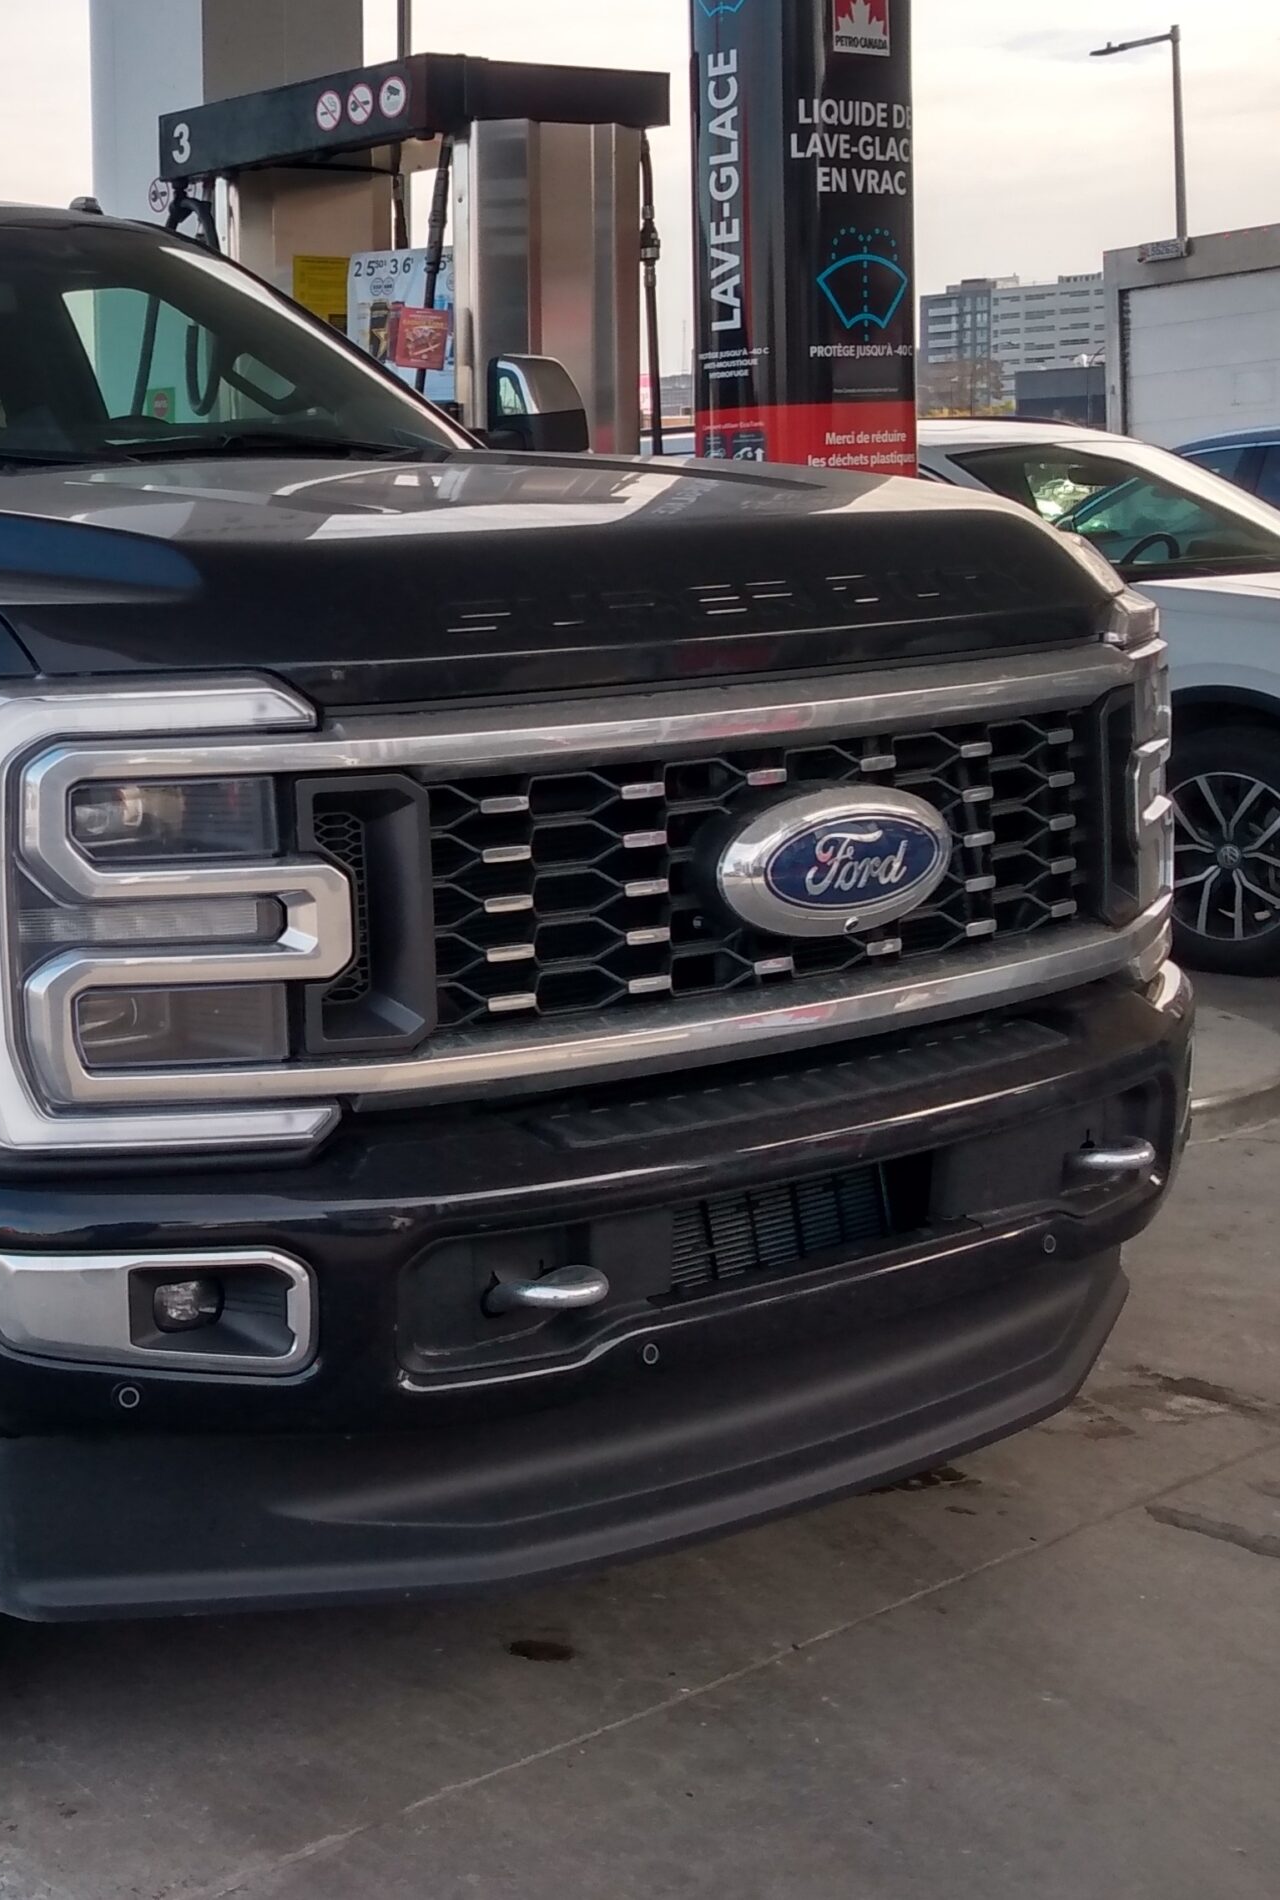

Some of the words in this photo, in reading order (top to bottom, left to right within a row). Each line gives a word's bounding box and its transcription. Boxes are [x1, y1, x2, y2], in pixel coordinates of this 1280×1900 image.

[798, 98, 888, 127] LIQUIDE
[172, 122, 191, 164] 3
[790, 132, 911, 163] LAVE-GLAC
[708, 48, 741, 332] LAVE-GLACE
[817, 166, 848, 193] EN
[851, 168, 907, 196] VRAC
[809, 343, 856, 358] PROTÈGE
[855, 342, 894, 359] JUSQU'À
[825, 431, 855, 446] Merci
[856, 431, 870, 444] de
[871, 429, 907, 443] réduire
[807, 454, 827, 468] les
[827, 452, 869, 467] déchets
[805, 830, 908, 896] Ford
